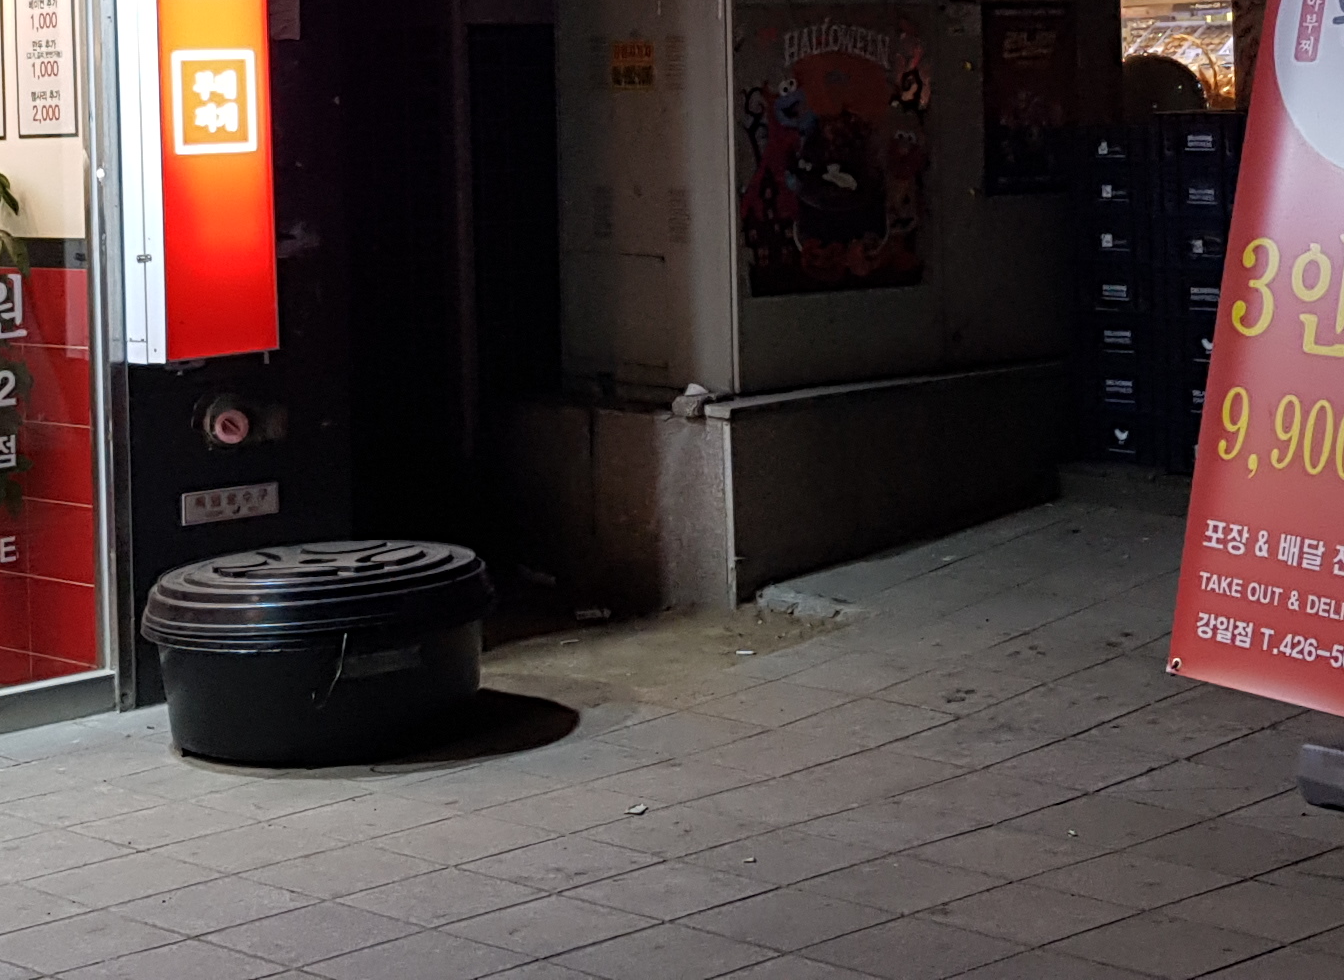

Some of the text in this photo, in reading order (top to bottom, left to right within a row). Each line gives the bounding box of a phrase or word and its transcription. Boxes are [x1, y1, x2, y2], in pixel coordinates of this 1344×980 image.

[31, 12, 58, 32] 1,000
[783, 17, 891, 68] HALLOWEEN
[32, 60, 59, 80] 1,000
[32, 104, 61, 124] 2,000
[1203, 519, 1250, 555] 포장
[1255, 529, 1270, 556] &
[1277, 533, 1325, 573] 배달
[1199, 572, 1243, 600] TAKE
[1247, 584, 1283, 607] OUT
[1287, 590, 1300, 609] &
[1197, 612, 1253, 649] 강일점
